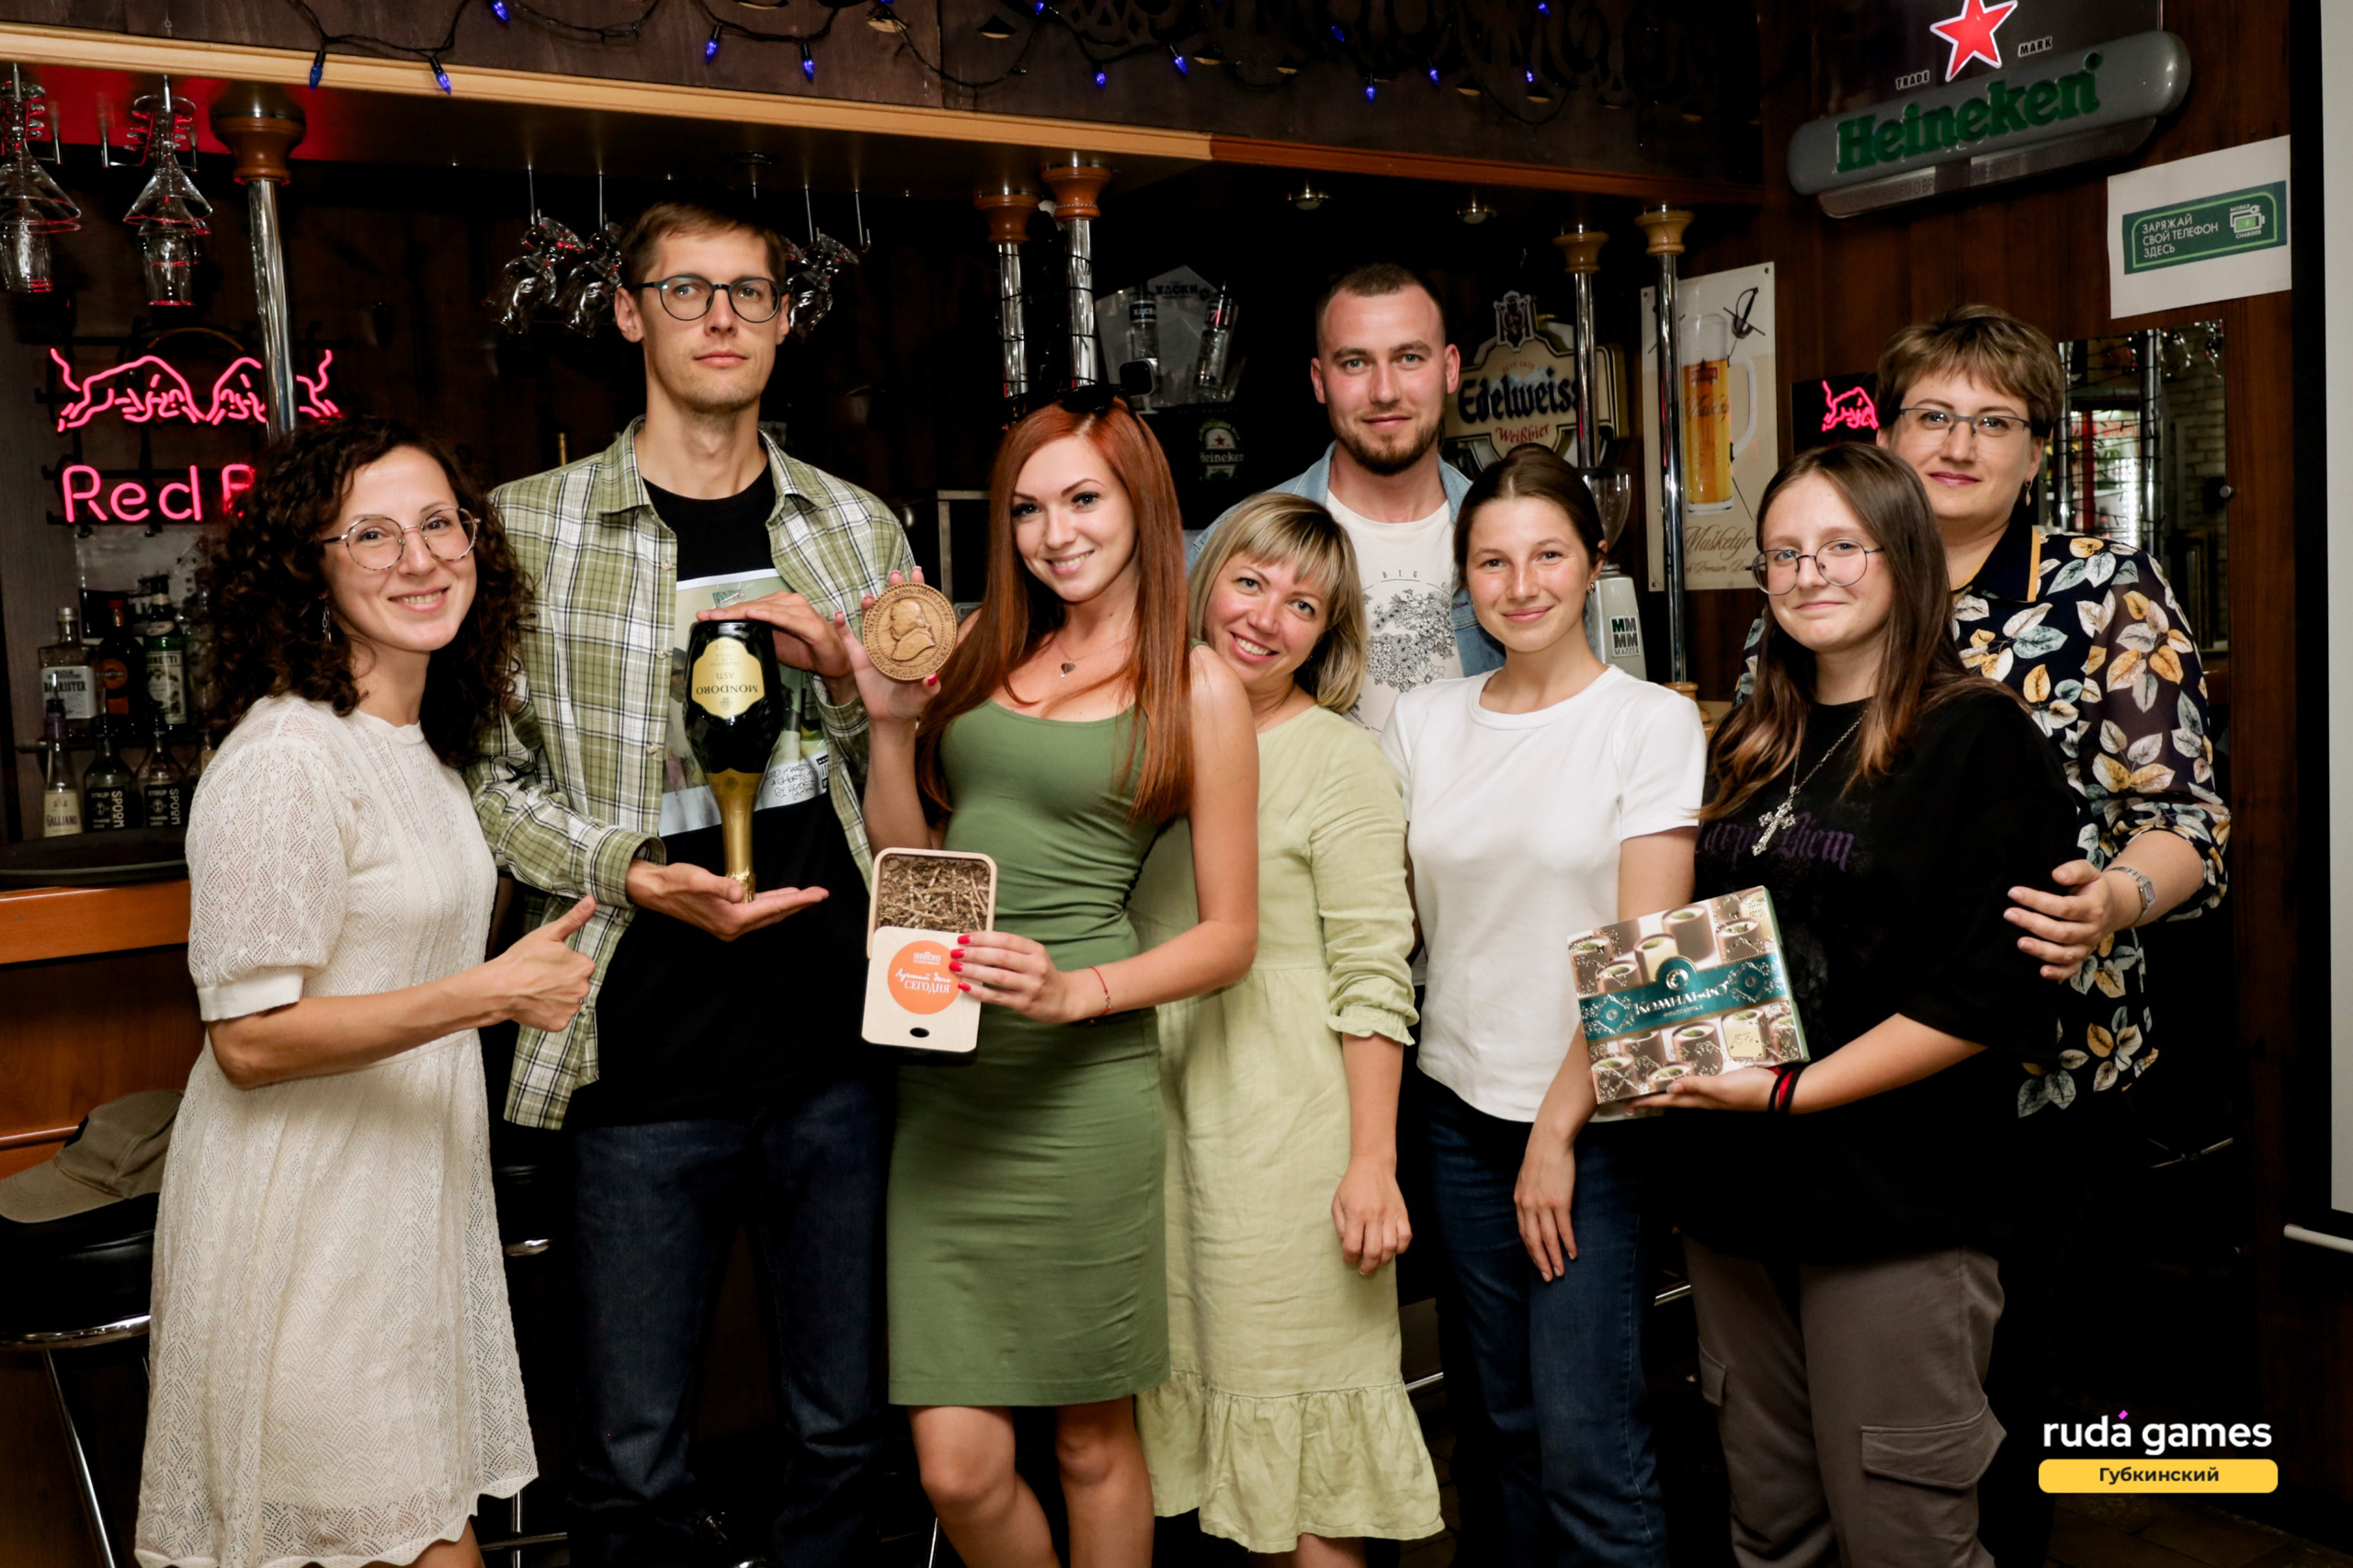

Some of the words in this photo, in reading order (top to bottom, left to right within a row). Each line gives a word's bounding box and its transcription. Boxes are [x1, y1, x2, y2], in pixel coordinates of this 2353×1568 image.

[1897, 73, 1928, 89] TRADE
[2019, 39, 2052, 55] MARK
[1836, 70, 2101, 173] Heineken
[2142, 212, 2193, 235] ЗАРЯЖАЙ
[2143, 230, 2171, 247] СВОЙ
[2172, 222, 2219, 241] ТЕЛЕФОН
[2143, 243, 2176, 259] ЗДЕСЬ
[1458, 366, 1579, 424] Edelweis
[1199, 451, 1245, 463] Heineken
[63, 464, 203, 524] Red
[697, 684, 758, 695] MONDORO
[904, 979, 950, 994] СЕГОДНЯ
